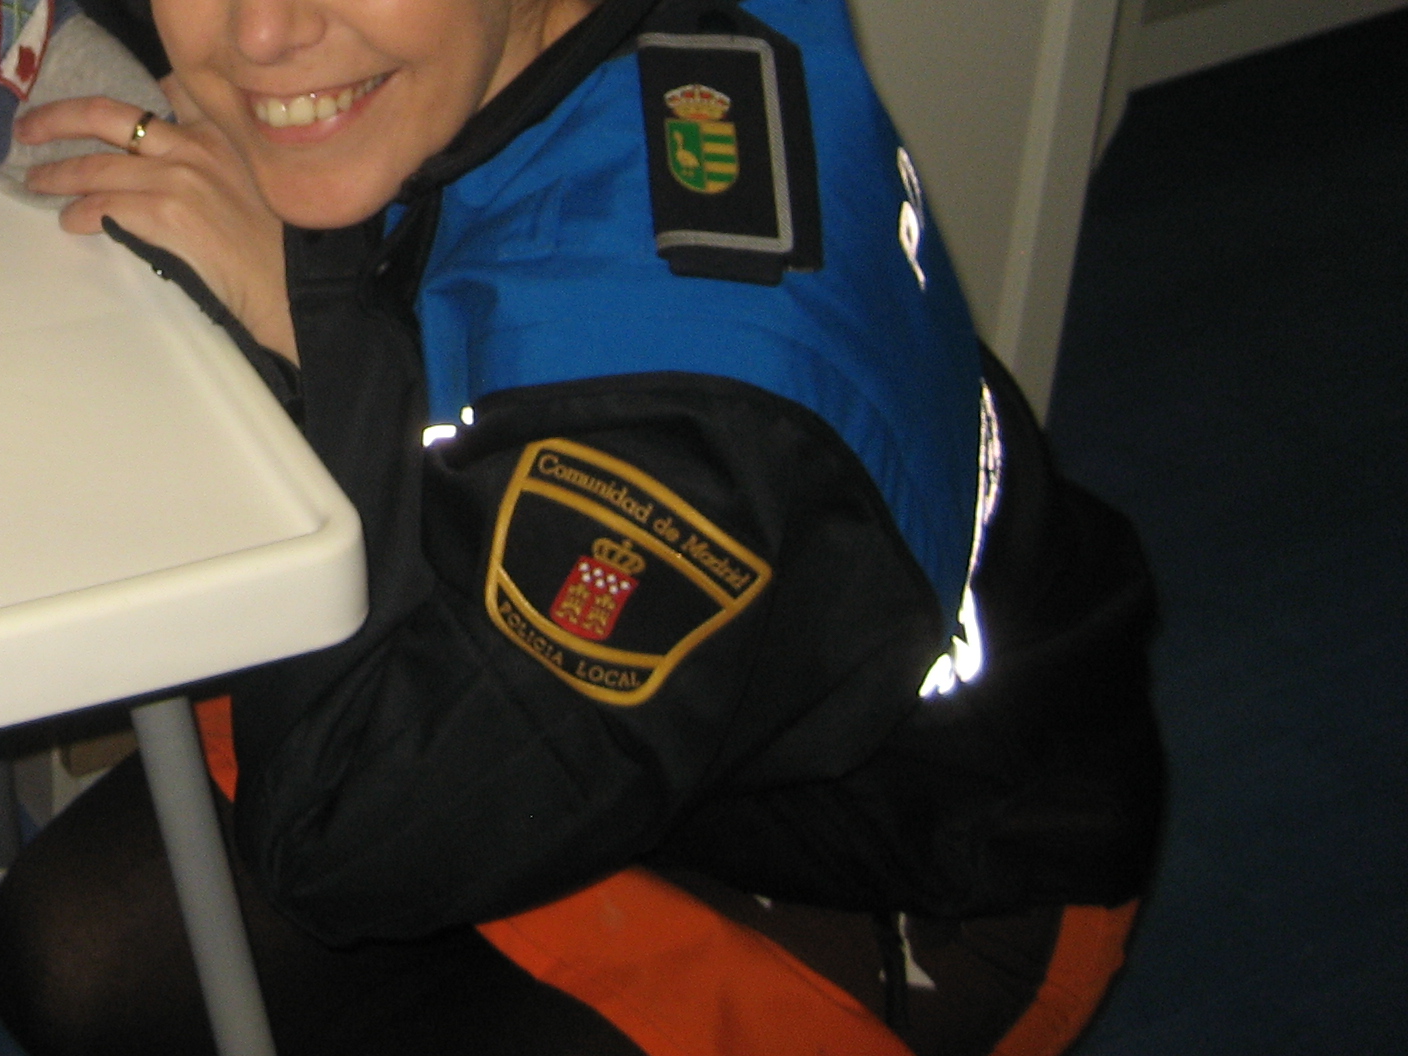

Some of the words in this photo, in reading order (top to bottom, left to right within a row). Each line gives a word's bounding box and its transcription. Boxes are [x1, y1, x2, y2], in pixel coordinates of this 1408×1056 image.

[537, 454, 653, 523] Comunidad
[652, 516, 681, 543] de
[680, 535, 751, 590] Madrid
[499, 601, 564, 667] POLICIA
[574, 659, 642, 688] LOCAL
